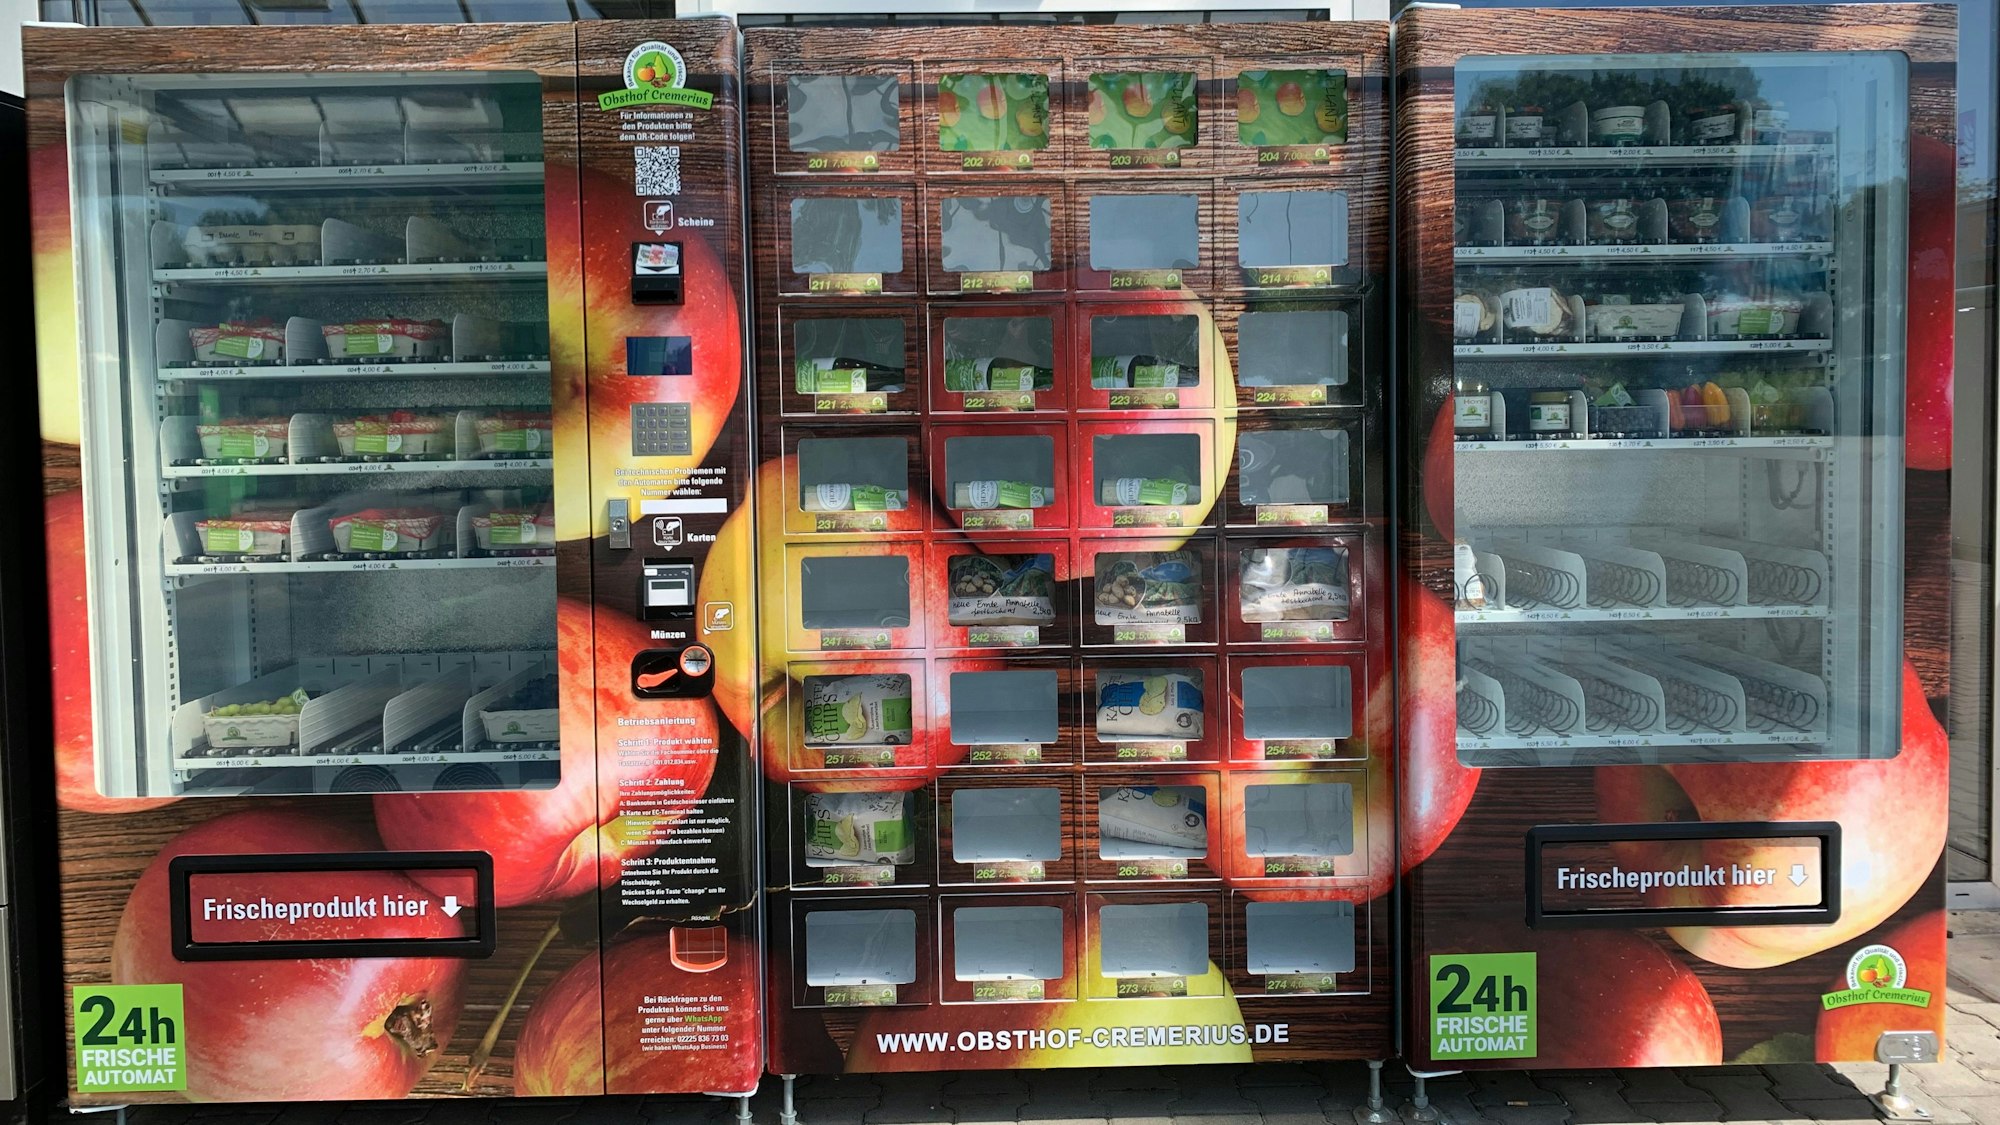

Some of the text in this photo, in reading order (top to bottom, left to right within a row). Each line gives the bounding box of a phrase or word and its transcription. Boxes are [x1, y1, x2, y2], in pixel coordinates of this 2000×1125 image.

[641, 44, 667, 53] Qualität
[603, 90, 709, 107] Obsthof Cremerius
[620, 111, 694, 120] Für Informationen zu
[622, 122, 692, 130] den Produkten bitte
[620, 132, 696, 142] dem QR-Code folgen!
[1111, 155, 1131, 165] 203
[1260, 152, 1280, 161] 204
[809, 159, 828, 168] 201
[963, 157, 982, 167] 202
[677, 217, 715, 227] Scheine
[964, 279, 983, 288] 212
[1112, 278, 1131, 287] 213
[1262, 274, 1281, 284] 214
[811, 281, 831, 290] 211
[1110, 395, 1130, 405] 223
[1256, 393, 1276, 402] 224
[816, 400, 836, 409] 221
[965, 398, 985, 408] 222
[615, 468, 626, 476] Bei
[674, 467, 713, 475] Problemen
[714, 466, 726, 474] mit
[633, 478, 673, 486] Automaten
[673, 477, 690, 485] bitte
[691, 477, 723, 486] folgende
[641, 487, 702, 496] Nummer wählen:
[817, 520, 836, 529] 231
[964, 517, 984, 526] 232
[1115, 515, 1134, 525] 233
[687, 533, 717, 542] Karten
[651, 629, 686, 639] Münzen
[970, 633, 989, 643] 242
[1116, 631, 1135, 640] 243
[617, 717, 696, 726] Betriebsanleitung
[823, 693, 841, 742] CHIPS
[618, 737, 713, 747] Schritt Produkt wählen
[1118, 748, 1137, 757] 253
[1267, 746, 1285, 755] 254
[825, 755, 844, 764] 251
[972, 751, 991, 761] 252
[619, 778, 685, 787] Schritt Zahlung
[652, 808, 686, 816] EC-Terminal
[652, 828, 667, 836] ohne
[702, 826, 725, 834] können)
[817, 808, 835, 856] CHIPS
[683, 837, 712, 845] einwerfen
[621, 857, 717, 867] Schritt Produktentnahme
[1119, 867, 1138, 876] 263
[1266, 863, 1285, 873] 264
[825, 874, 844, 883] 261
[976, 869, 995, 879] 262
[1557, 863, 1777, 893] Frischeprodukt hier
[621, 879, 662, 888] Frischeklappe.
[656, 888, 665, 896] die
[622, 898, 658, 906] Wechselgeld
[203, 894, 429, 925] Frischeprodukt hier
[1864, 947, 1890, 956] Qualität
[1119, 984, 1138, 994] 273
[1268, 980, 1287, 989] 274
[1436, 964, 1528, 1014] 24h
[827, 993, 846, 1002] 271
[975, 988, 995, 997] 272
[1827, 989, 1927, 1006] Obsthof Cremerius
[644, 996, 657, 1004] Bei
[657, 995, 698, 1005] Rückfragen
[709, 995, 722, 1003] den
[638, 1006, 674, 1014] Produkten
[675, 1005, 702, 1014] können
[702, 1004, 715, 1012] Sie
[80, 995, 176, 1046] 24h
[645, 1014, 723, 1025] gerne über WhatsApp
[641, 1025, 727, 1035] unter folgender Nummer
[1436, 1015, 1528, 1035] FRISCHE
[640, 1036, 677, 1045] erreichen:
[677, 1035, 697, 1043] 02225
[711, 1034, 720, 1042] 73
[720, 1034, 729, 1042] 03
[876, 1023, 1289, 1054] WWW.OBSTHOF-CREMERIUS.DE
[672, 1043, 700, 1053] WhatsApp
[701, 1043, 728, 1051] Business)
[1437, 1035, 1528, 1053] AUTOMAT
[82, 1048, 176, 1068] FRISCHE
[84, 1068, 176, 1085] AUTOMAT
